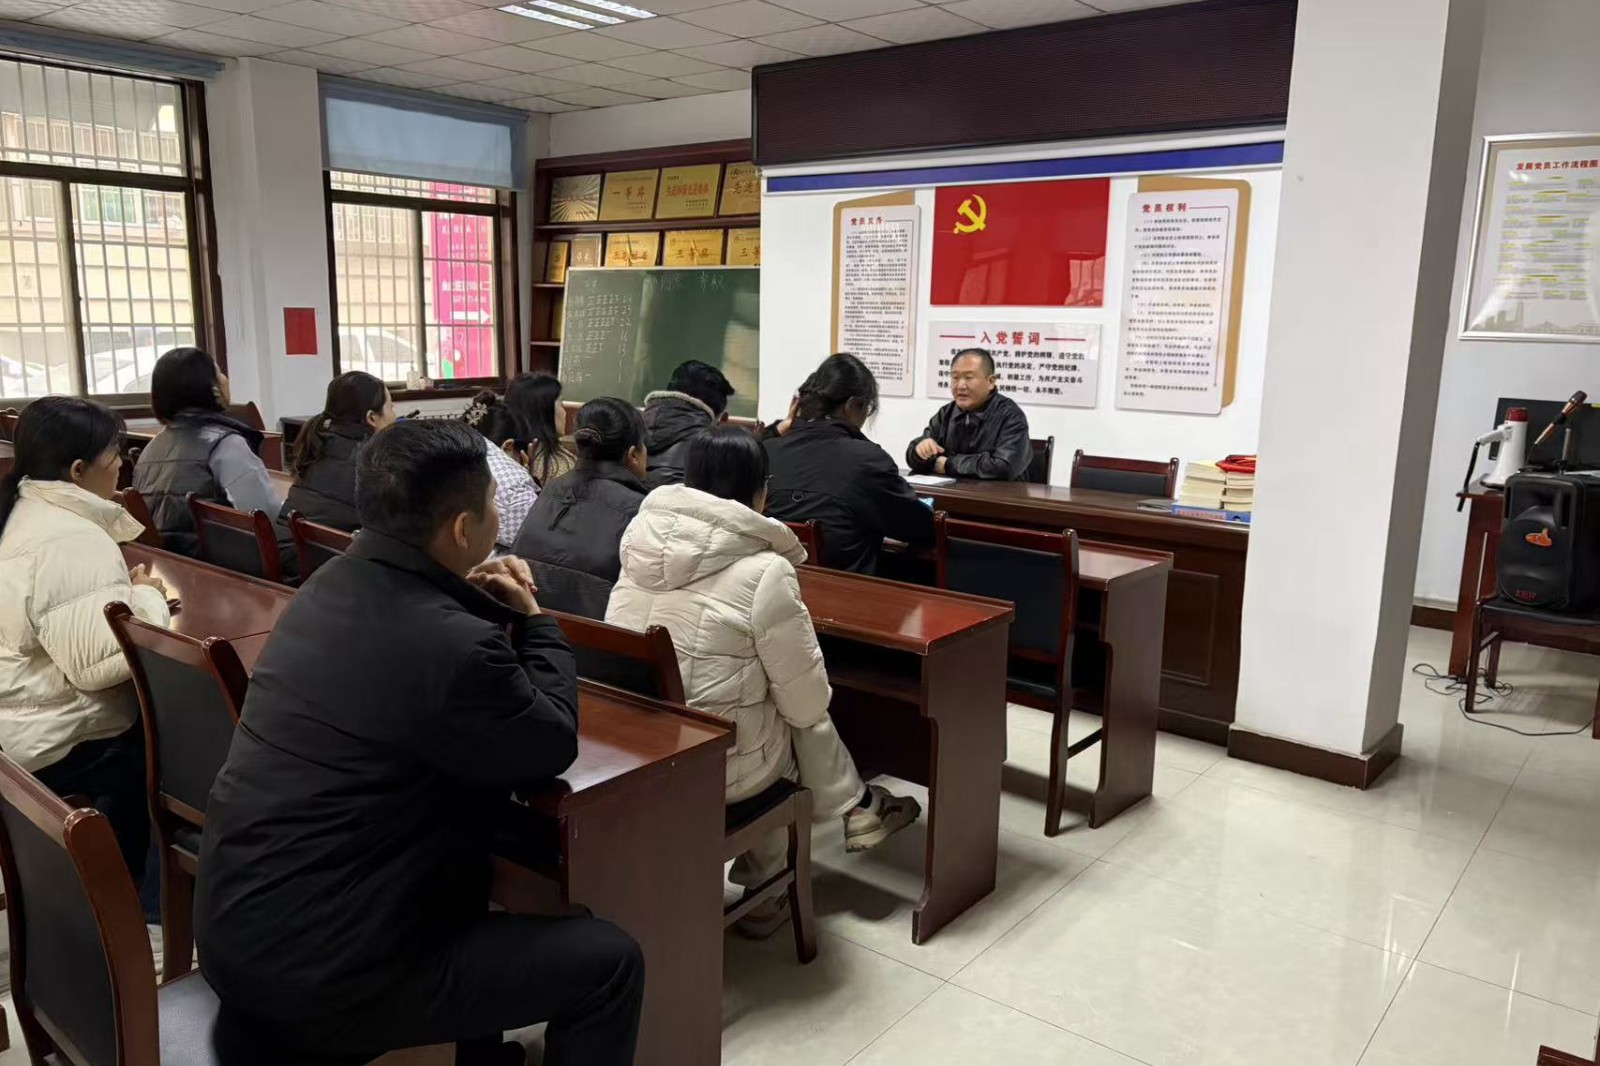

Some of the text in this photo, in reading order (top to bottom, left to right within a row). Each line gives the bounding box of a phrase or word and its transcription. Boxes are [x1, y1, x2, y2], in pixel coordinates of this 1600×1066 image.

[1516, 160, 1598, 171] 发展党员工作流程图
[1142, 203, 1187, 213] 党员权利
[980, 330, 1040, 346] 入党誓词
